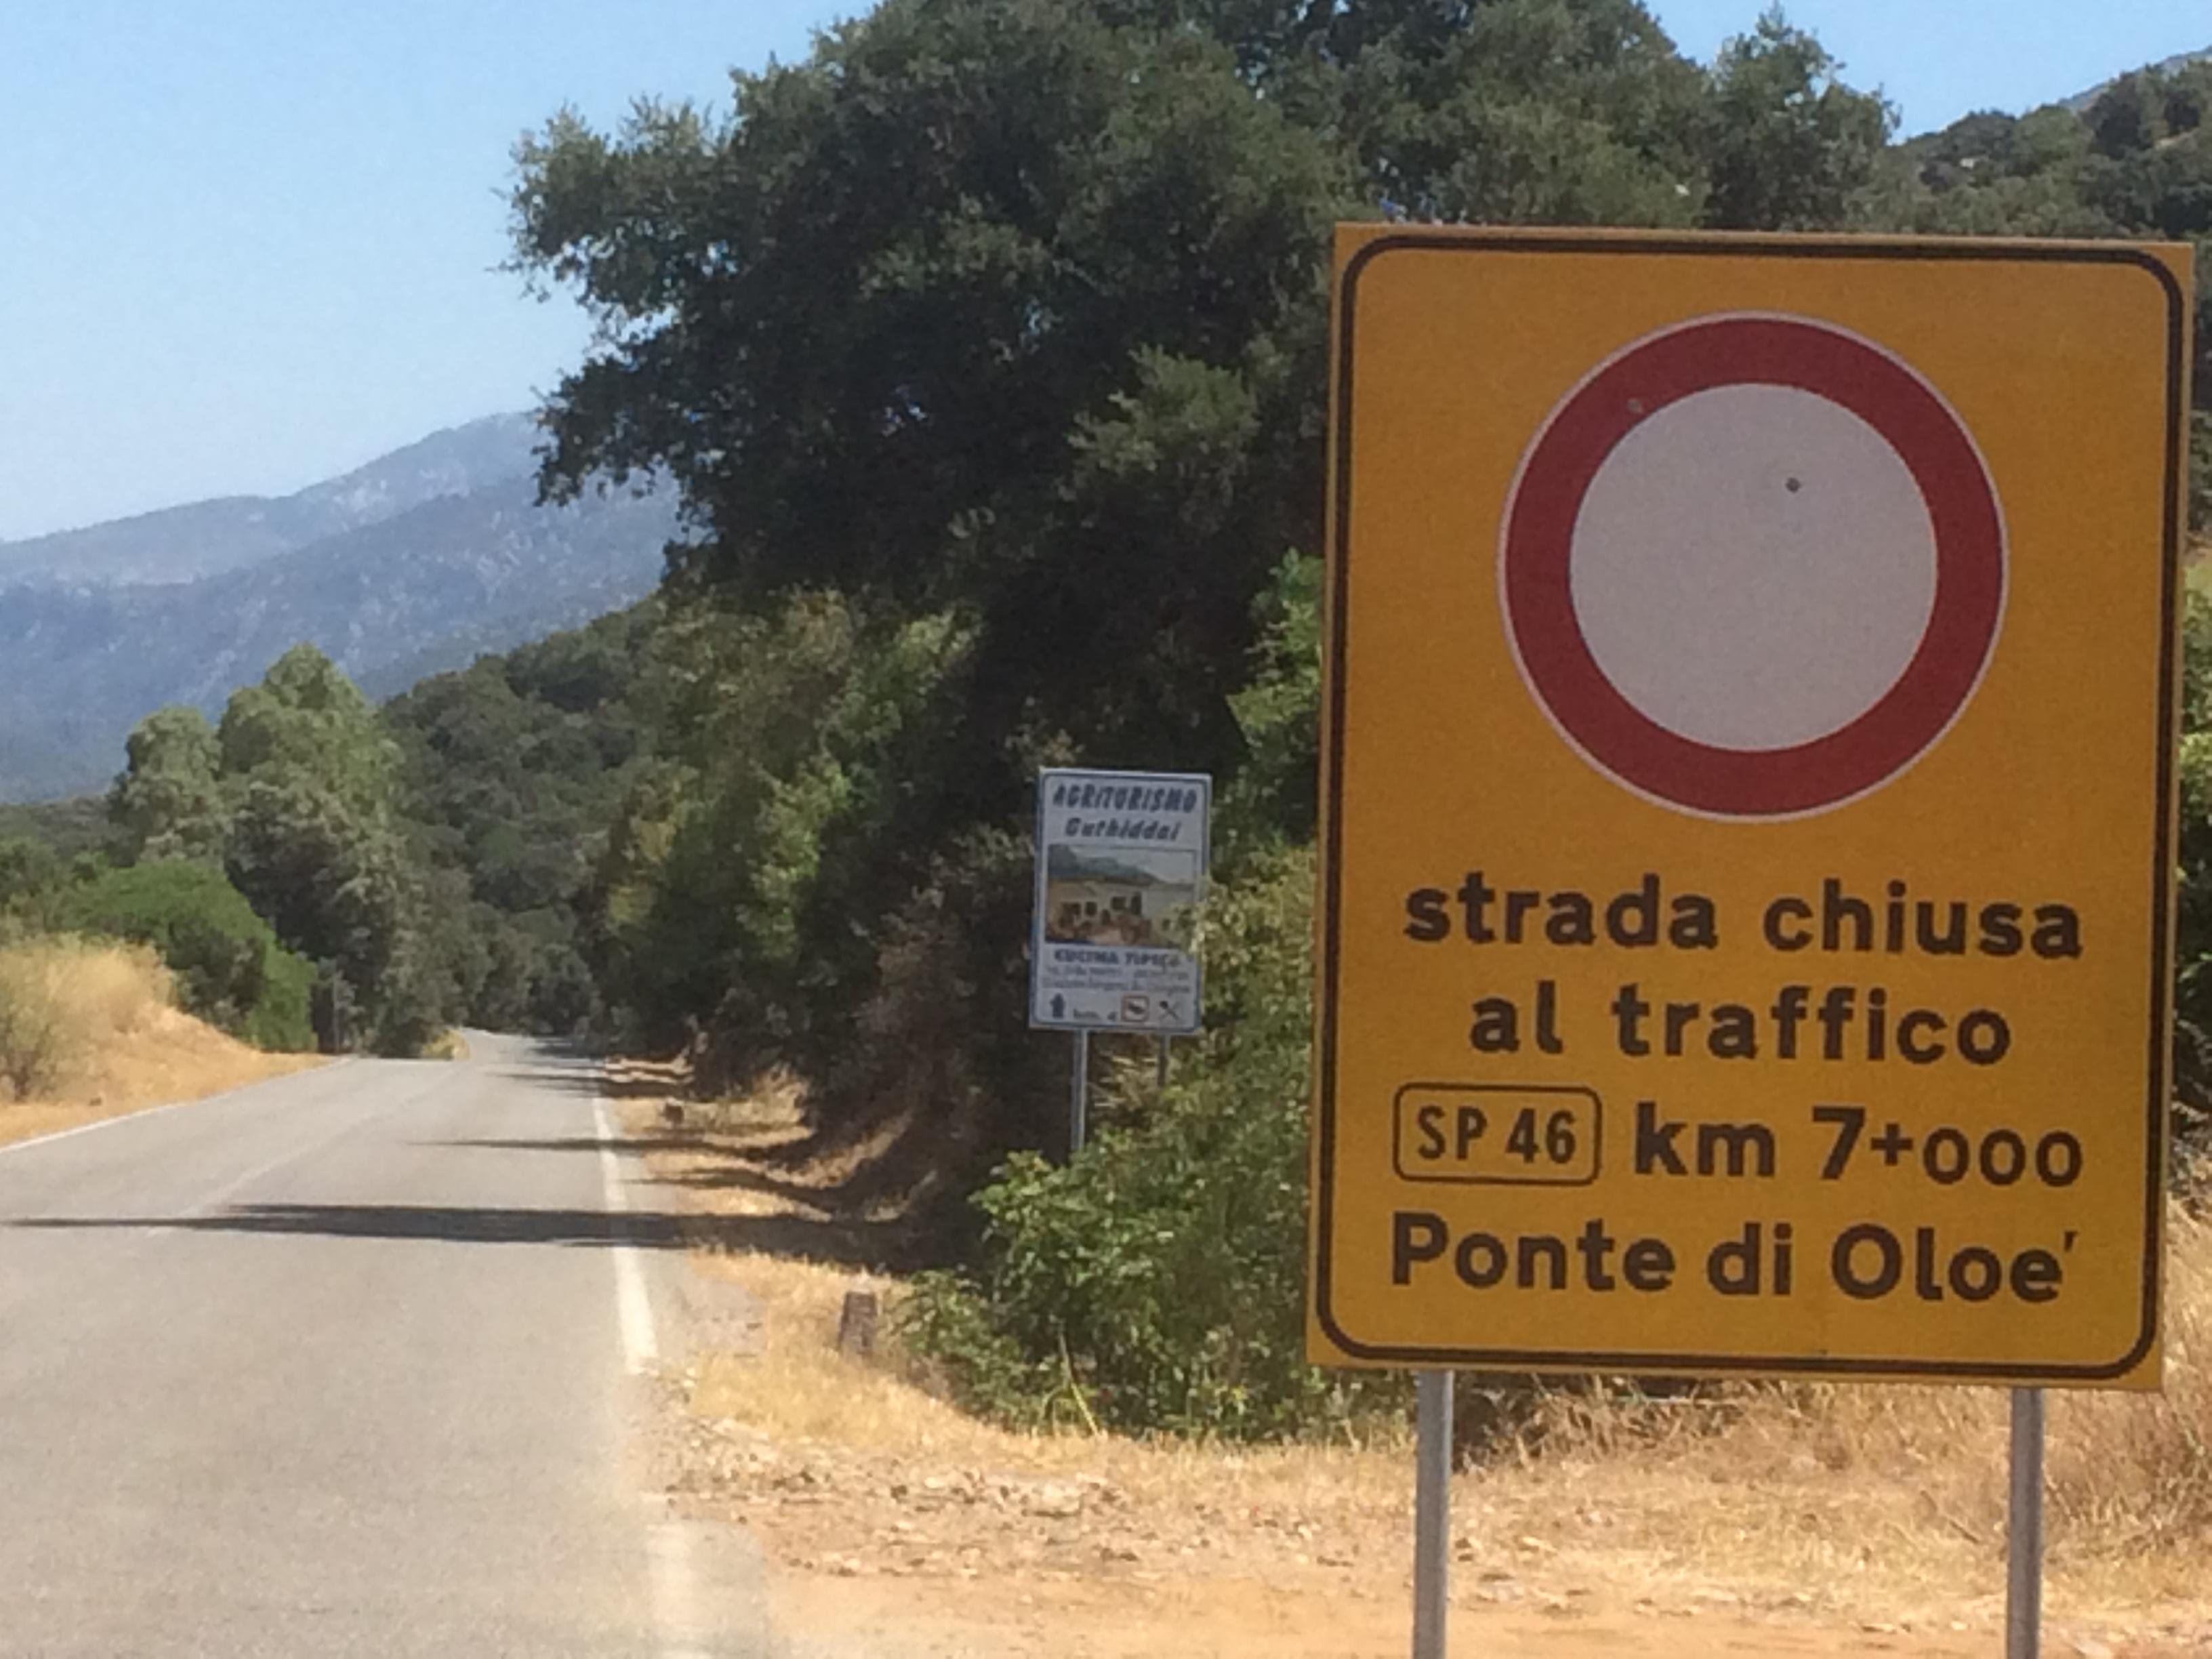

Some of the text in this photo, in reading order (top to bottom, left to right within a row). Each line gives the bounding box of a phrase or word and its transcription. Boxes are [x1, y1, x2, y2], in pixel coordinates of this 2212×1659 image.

[1052, 784, 1197, 813] AGRITURISMO
[1404, 872, 2083, 960] strada chiusa
[1470, 981, 2010, 1065] al traffico
[1418, 1101, 2083, 1187] SP 46 km 7+000
[1392, 1212, 1675, 1292] Ponte
[1706, 1223, 1793, 1296] di
